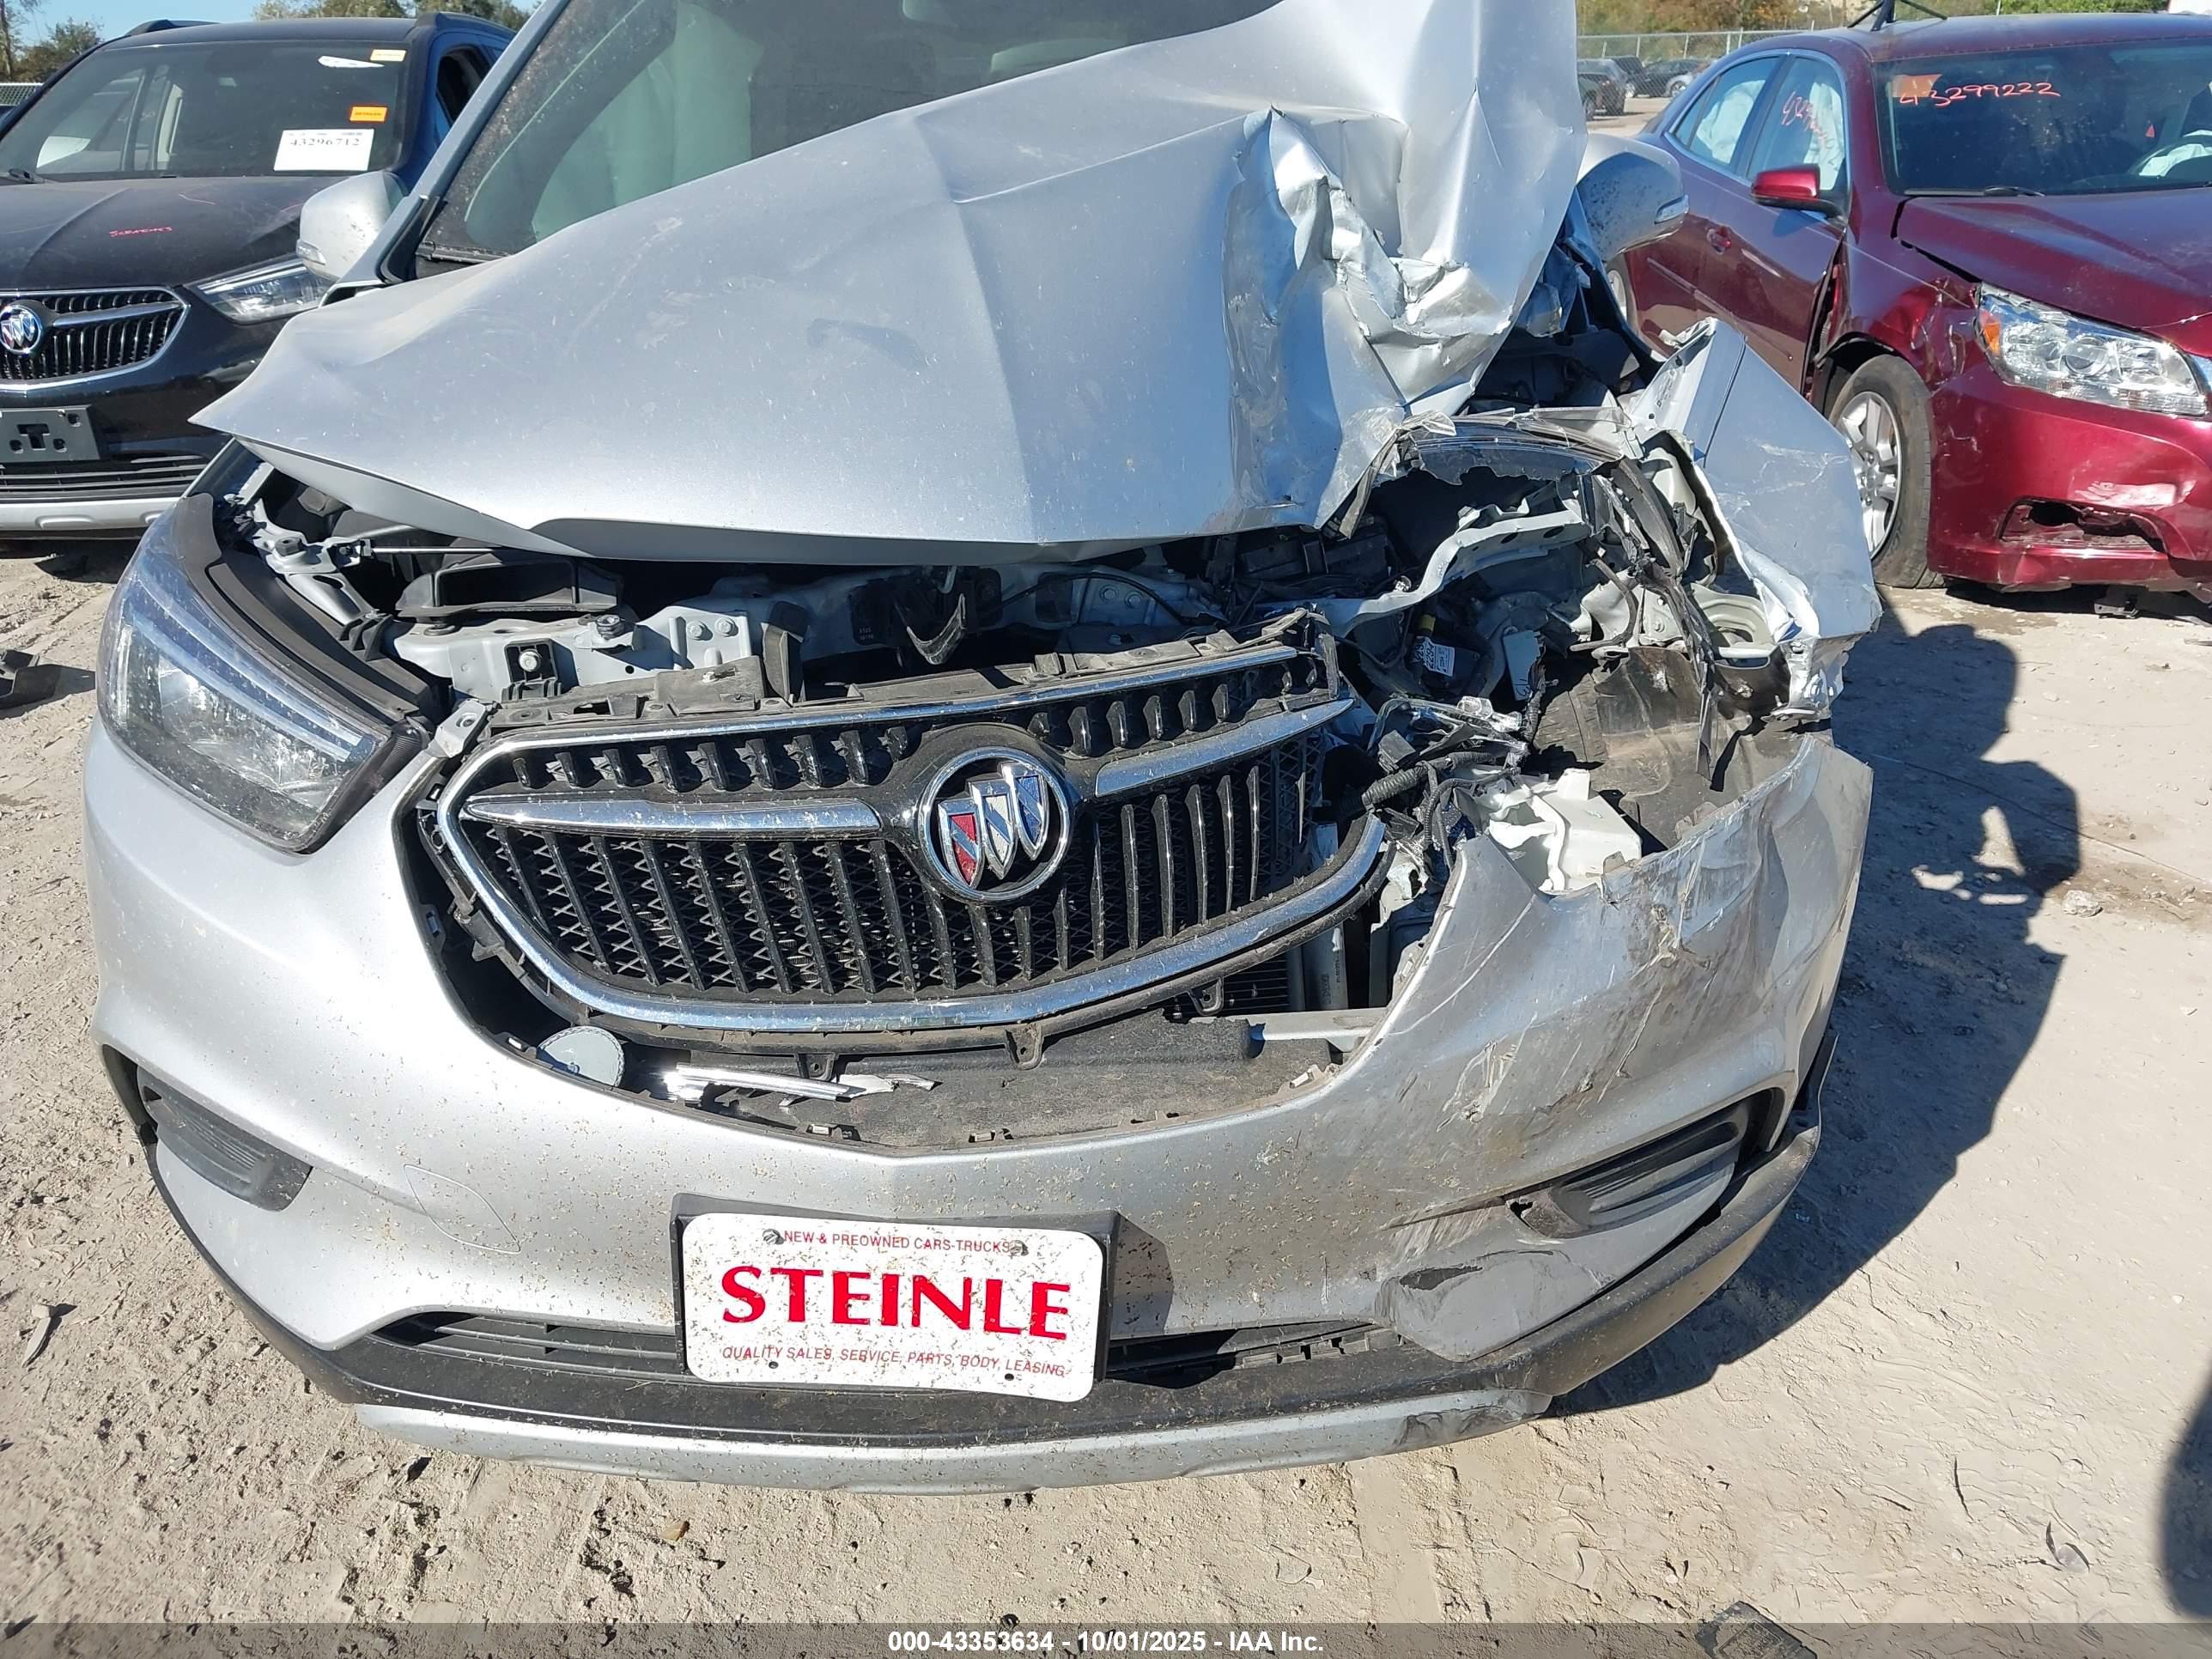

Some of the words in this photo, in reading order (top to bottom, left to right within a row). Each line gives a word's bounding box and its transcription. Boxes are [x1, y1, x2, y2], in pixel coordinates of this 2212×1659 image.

[1899, 80, 2061, 106] 43299222
[784, 1230, 815, 1243] NEW
[818, 1232, 828, 1244] &
[832, 1233, 910, 1249] PREOWNED
[722, 1266, 1071, 1340] STEINLE
[722, 1346, 783, 1360] QUALITY
[839, 1348, 902, 1364] SERVICE,
[1006, 1358, 1066, 1378] LEASING
